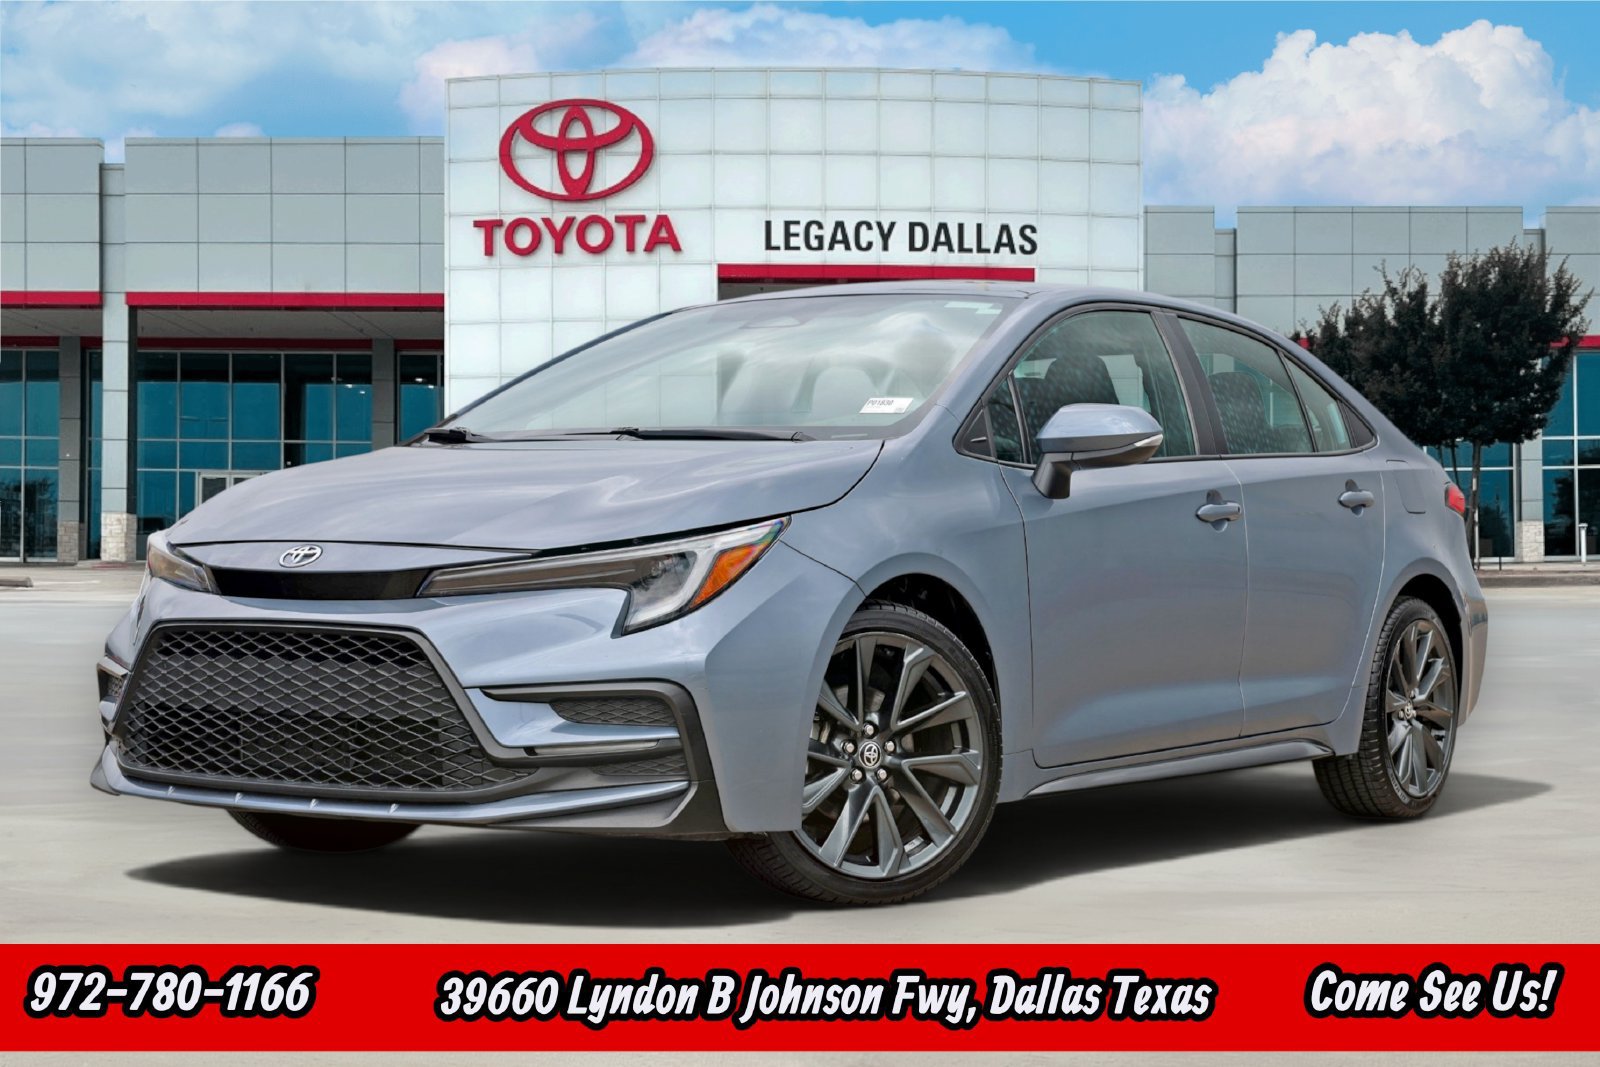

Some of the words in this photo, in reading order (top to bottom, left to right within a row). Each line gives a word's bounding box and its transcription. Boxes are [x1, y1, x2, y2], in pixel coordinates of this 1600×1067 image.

[473, 214, 682, 257] TOYOTA
[764, 220, 897, 252] LEGACY
[907, 221, 1038, 255] DALLAS
